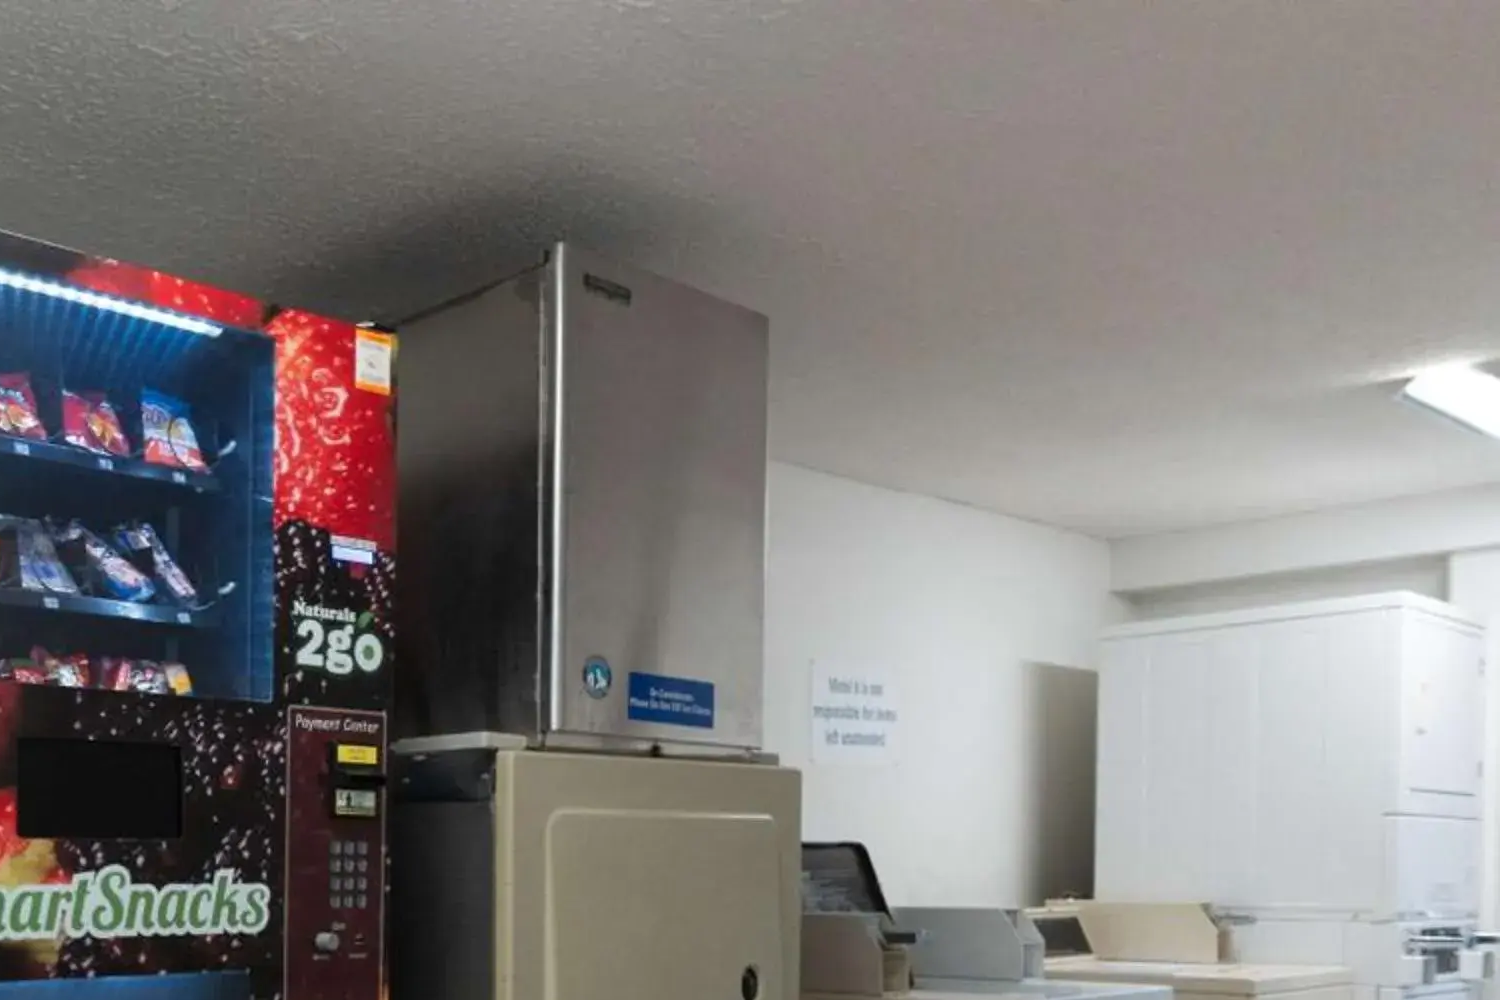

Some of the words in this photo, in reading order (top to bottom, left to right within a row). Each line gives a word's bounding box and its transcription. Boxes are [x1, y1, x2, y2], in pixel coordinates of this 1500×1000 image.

[292, 598, 356, 623] Naturals
[295, 713, 341, 732] Payment
[343, 718, 380, 734] Center
